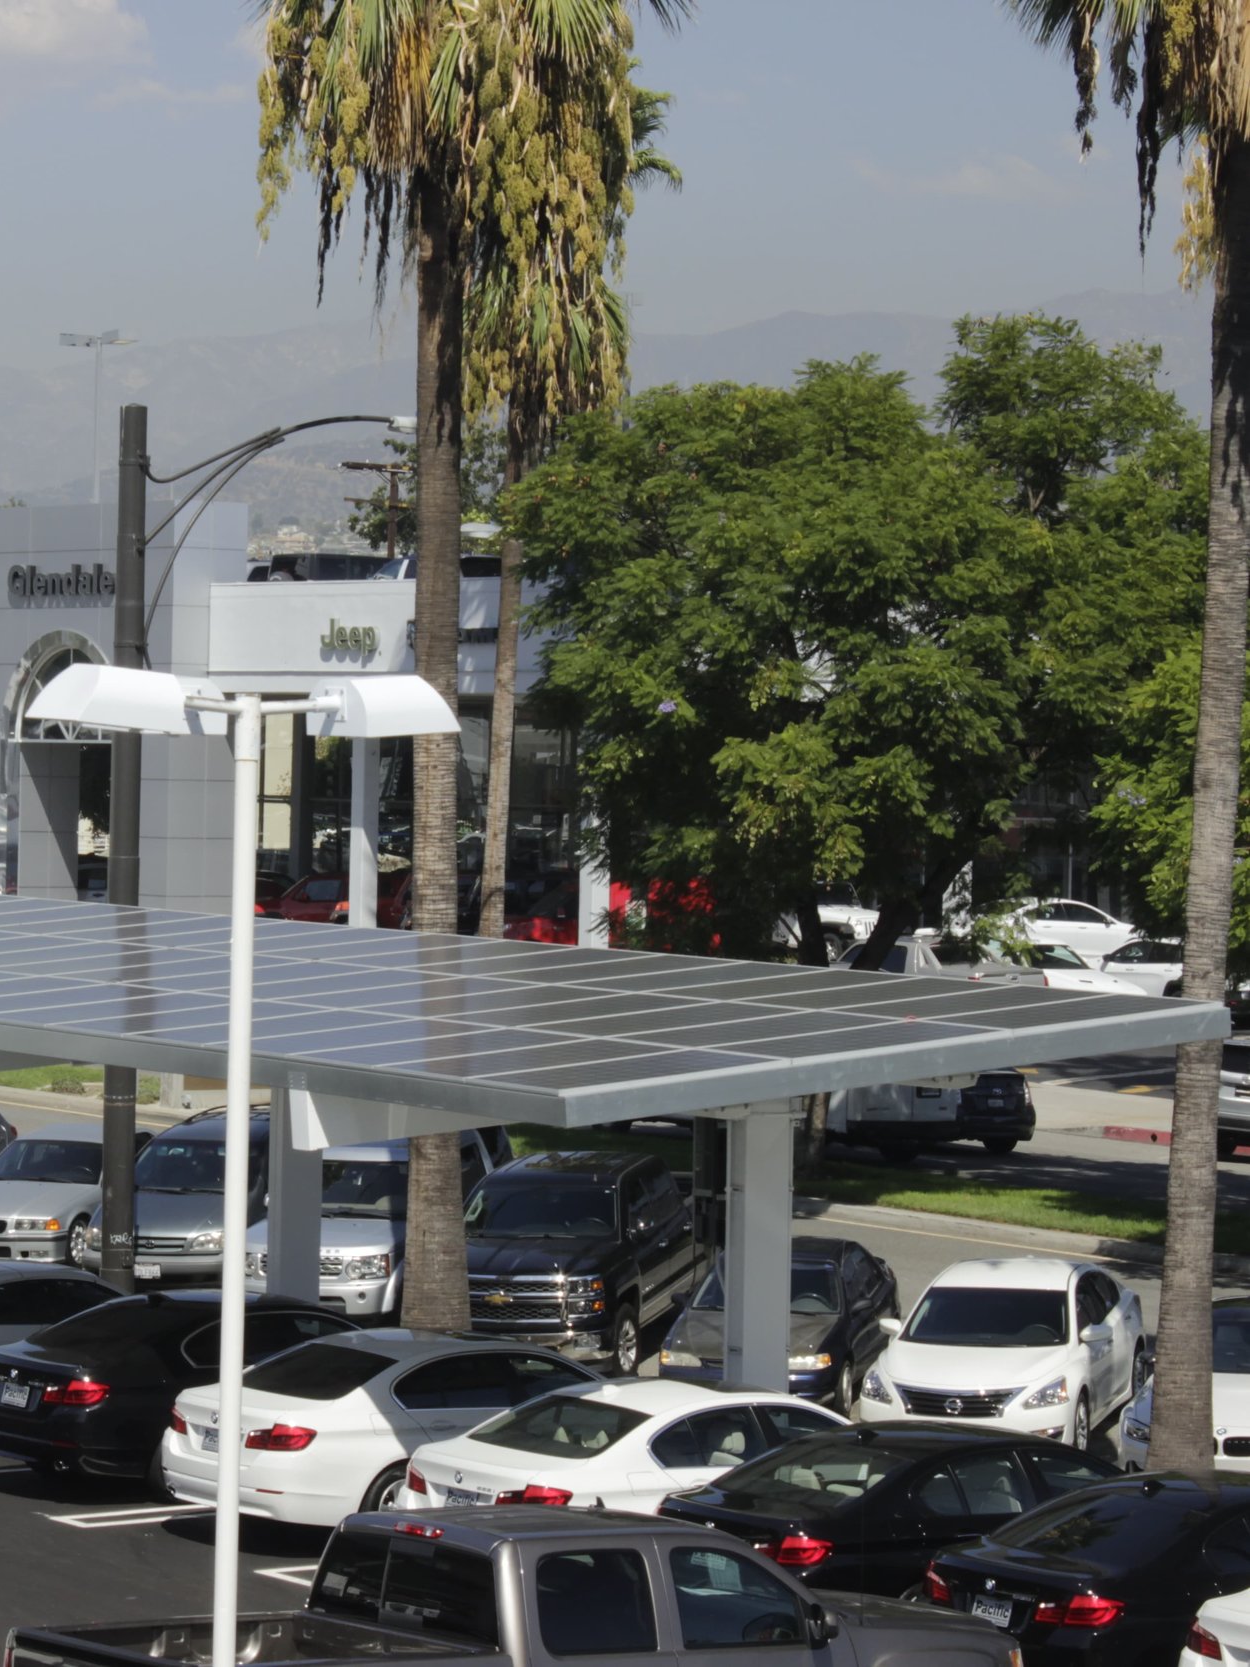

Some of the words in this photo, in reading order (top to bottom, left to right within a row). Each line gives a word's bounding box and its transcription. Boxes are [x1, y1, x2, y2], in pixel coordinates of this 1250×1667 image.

[8, 563, 116, 597] Glendale
[320, 618, 377, 656] Jeep
[975, 1599, 1010, 1619] Pacific
